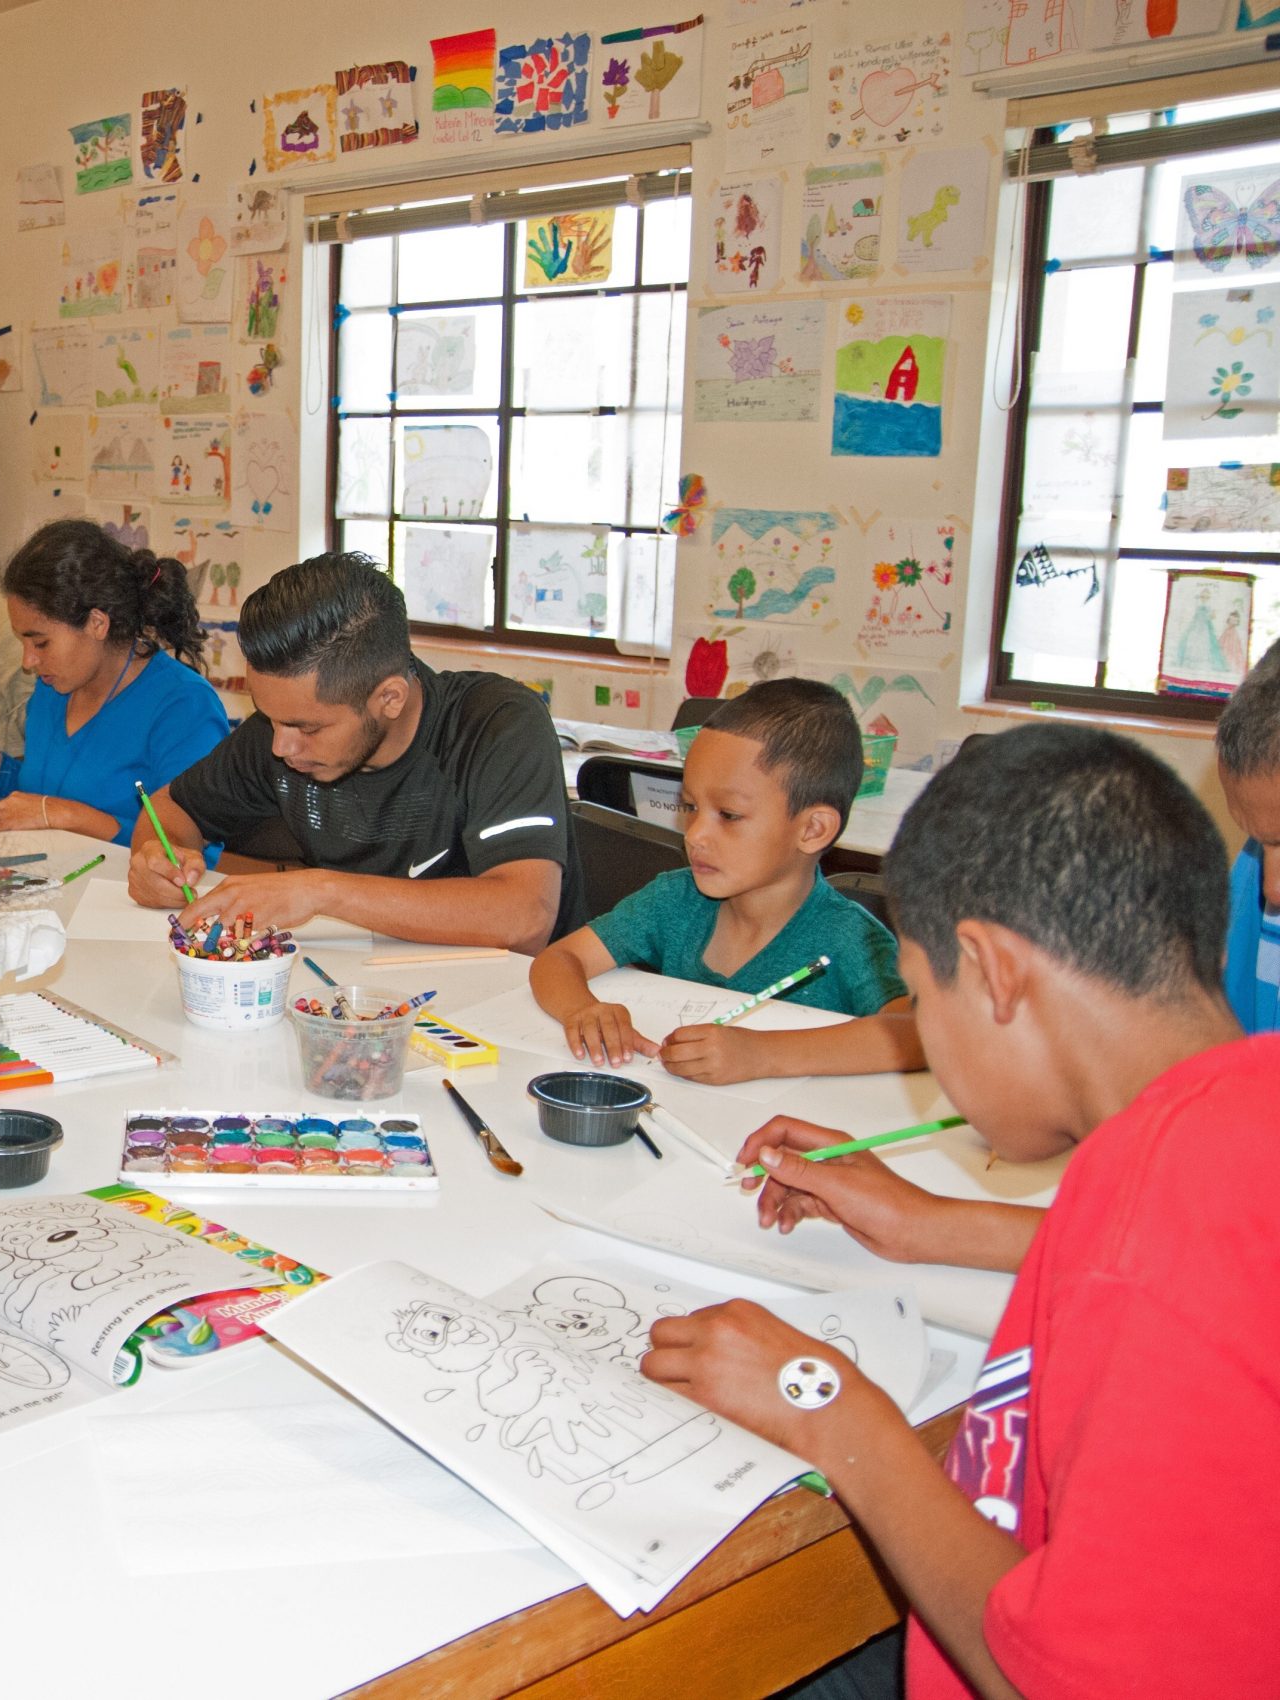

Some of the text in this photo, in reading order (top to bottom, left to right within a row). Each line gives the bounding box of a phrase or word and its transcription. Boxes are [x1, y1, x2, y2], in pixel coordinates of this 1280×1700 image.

[649, 799, 681, 813] DO NOT
[90, 1282, 190, 1357] Resting in the Shade
[9, 1405, 23, 1415] at
[23, 1399, 40, 1409] me
[714, 1461, 757, 1492] Big Splash
